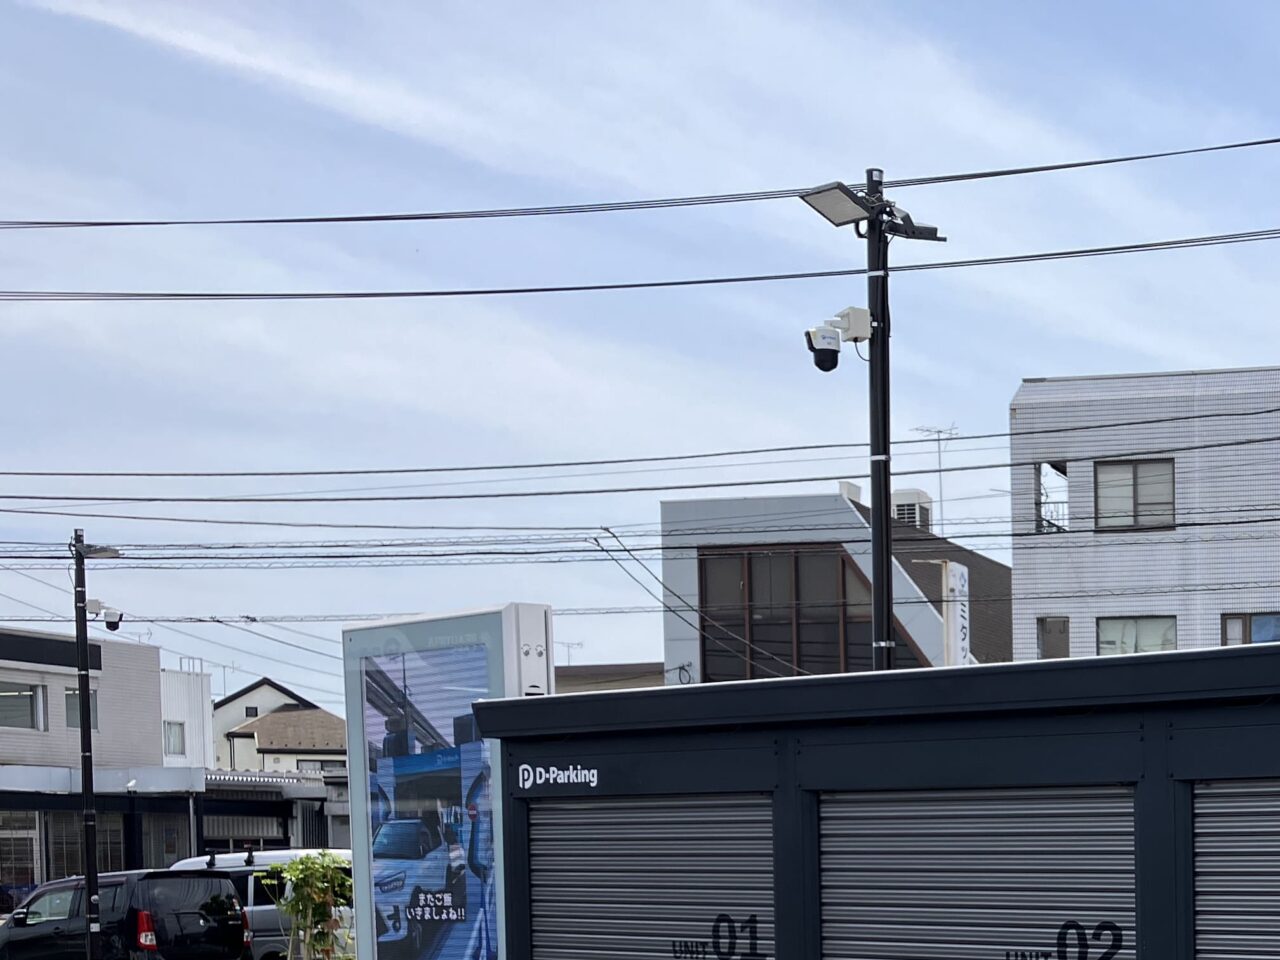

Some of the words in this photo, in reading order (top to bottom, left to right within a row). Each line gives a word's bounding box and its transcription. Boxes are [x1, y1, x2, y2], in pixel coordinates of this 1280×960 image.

[535, 764, 598, 787] D-Parking
[418, 892, 453, 906] またご飯
[672, 940, 709, 960] UNIT
